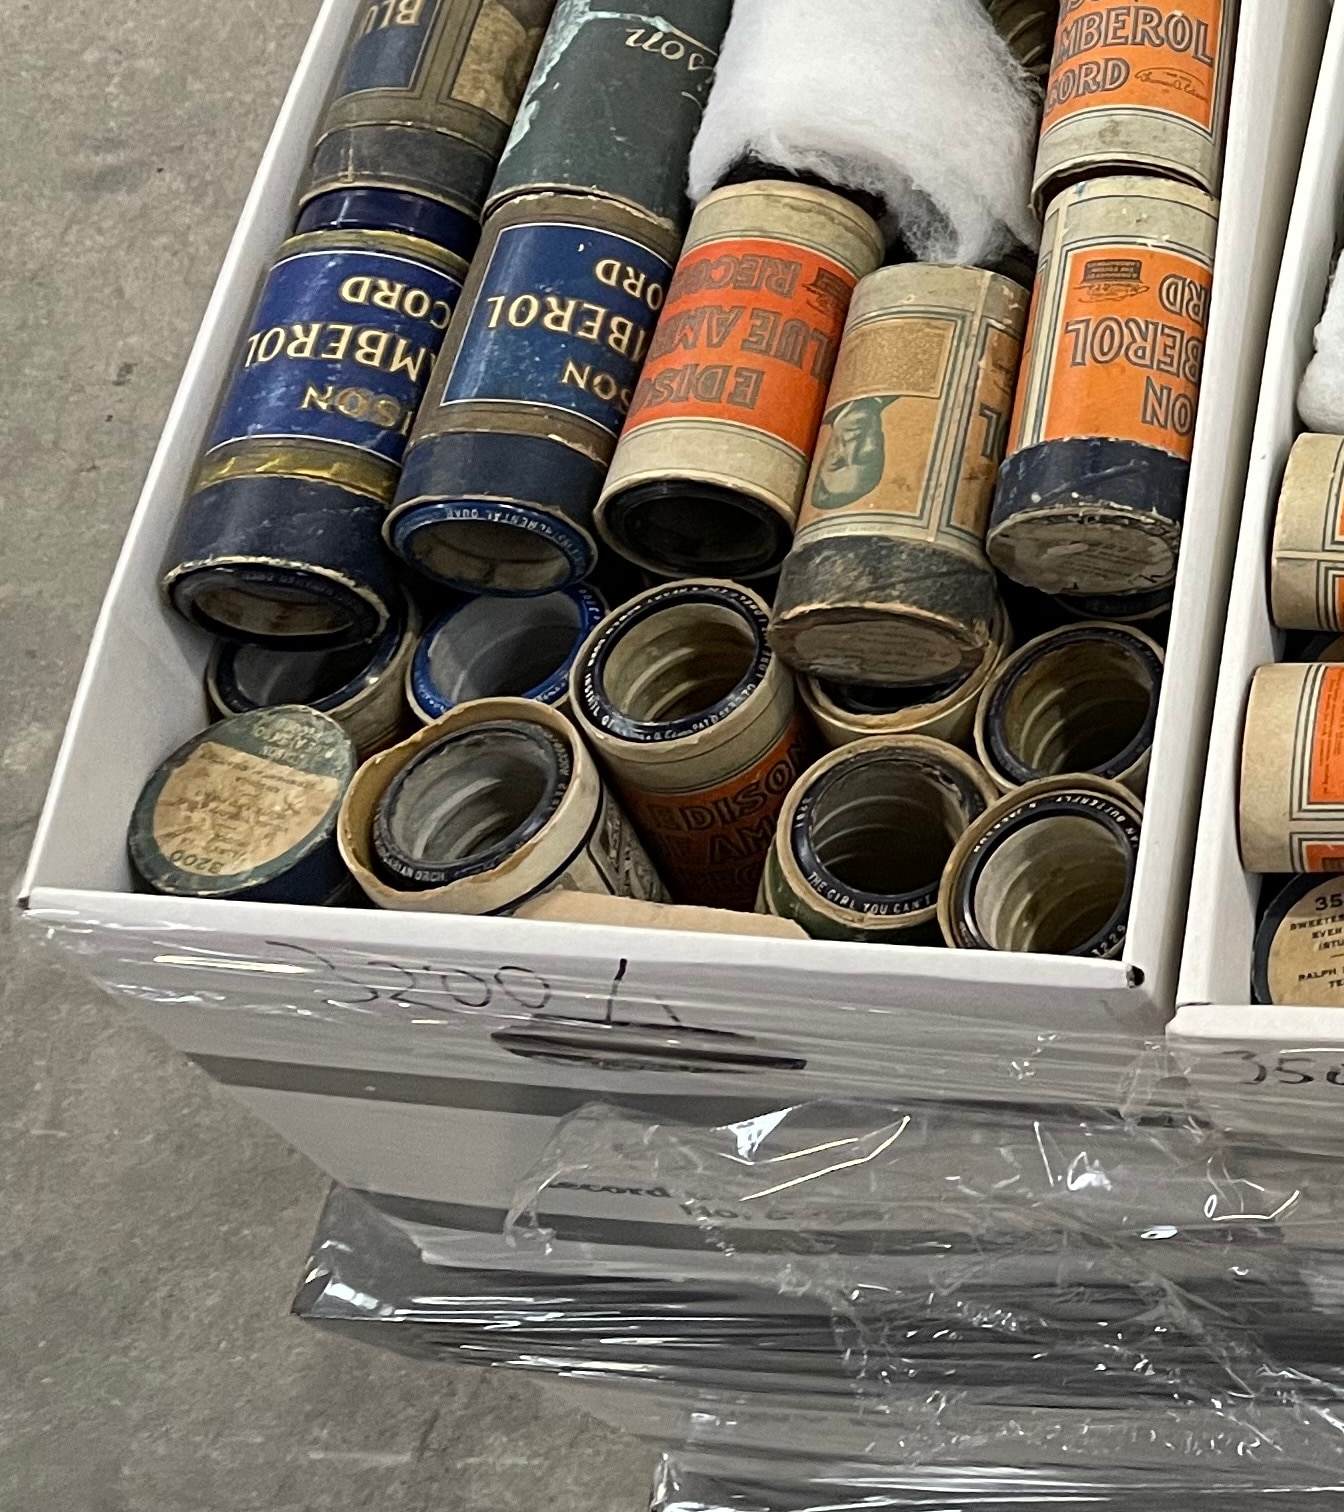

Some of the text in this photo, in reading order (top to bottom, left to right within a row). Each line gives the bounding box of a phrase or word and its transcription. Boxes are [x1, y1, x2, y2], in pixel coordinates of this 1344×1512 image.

[170, 850, 224, 873] 3200
[807, 871, 828, 892] THE
[863, 902, 889, 915] YOU
[894, 893, 932, 913] CAN'T
[1311, 927, 1343, 939] EVEN
[1298, 968, 1337, 982] RALPH
